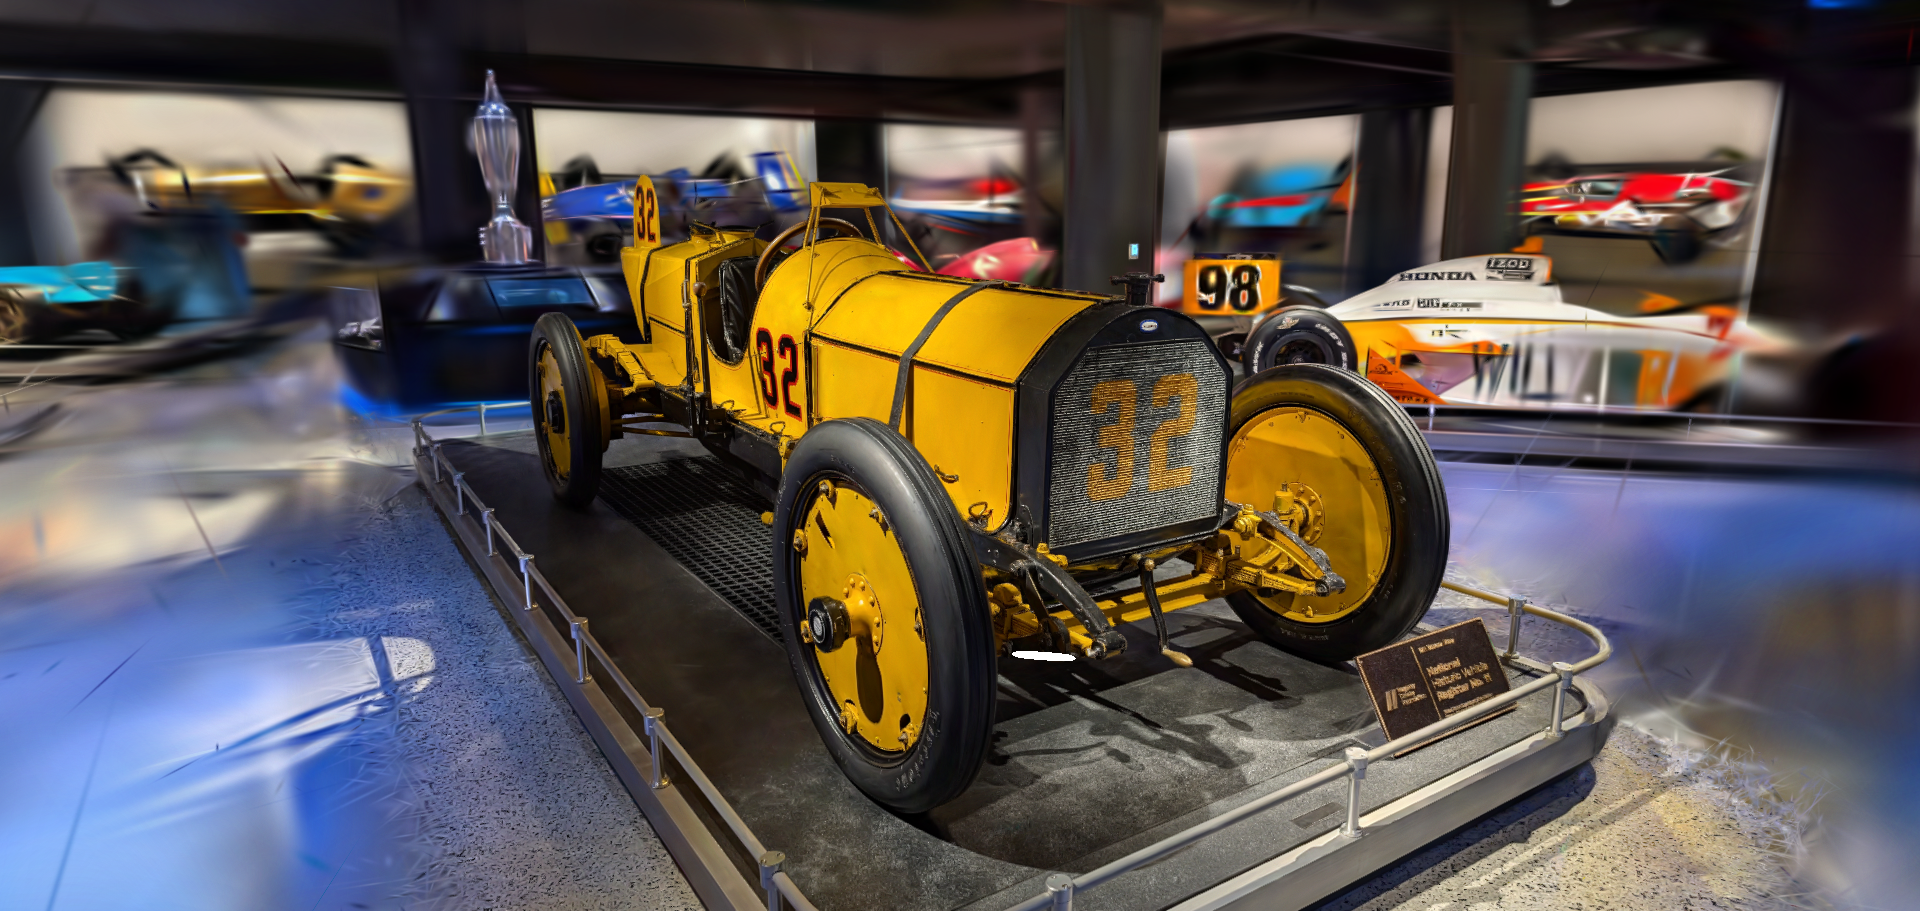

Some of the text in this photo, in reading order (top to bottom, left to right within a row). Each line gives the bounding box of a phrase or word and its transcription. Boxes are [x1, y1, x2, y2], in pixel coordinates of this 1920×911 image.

[636, 185, 657, 243] 32
[1399, 271, 1477, 282] HONDA
[1488, 257, 1532, 270] IZOD
[1197, 263, 1260, 312] 98
[756, 327, 803, 422] 32
[1086, 372, 1199, 504] 32
[1426, 656, 1461, 678] National
[1436, 682, 1470, 702] Register
